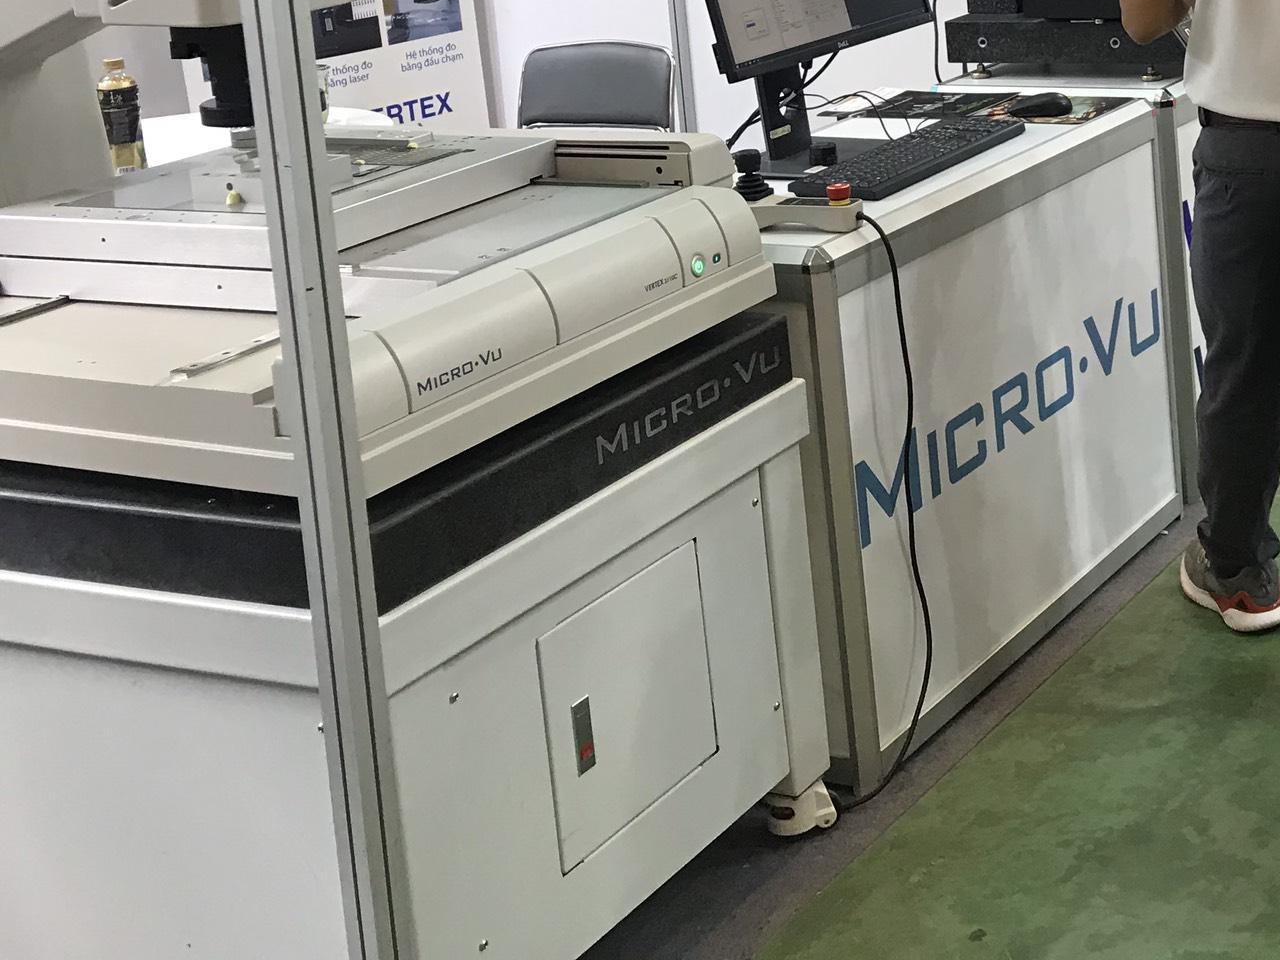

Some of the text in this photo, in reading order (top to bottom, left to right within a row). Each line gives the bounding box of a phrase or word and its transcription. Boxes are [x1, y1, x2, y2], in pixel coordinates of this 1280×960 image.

[405, 42, 457, 61] Hệ thống đo
[331, 60, 373, 77] thống đo
[401, 62, 422, 73] bằng
[441, 53, 464, 65] chạm
[349, 73, 370, 83] laser
[370, 91, 453, 124] RTEX
